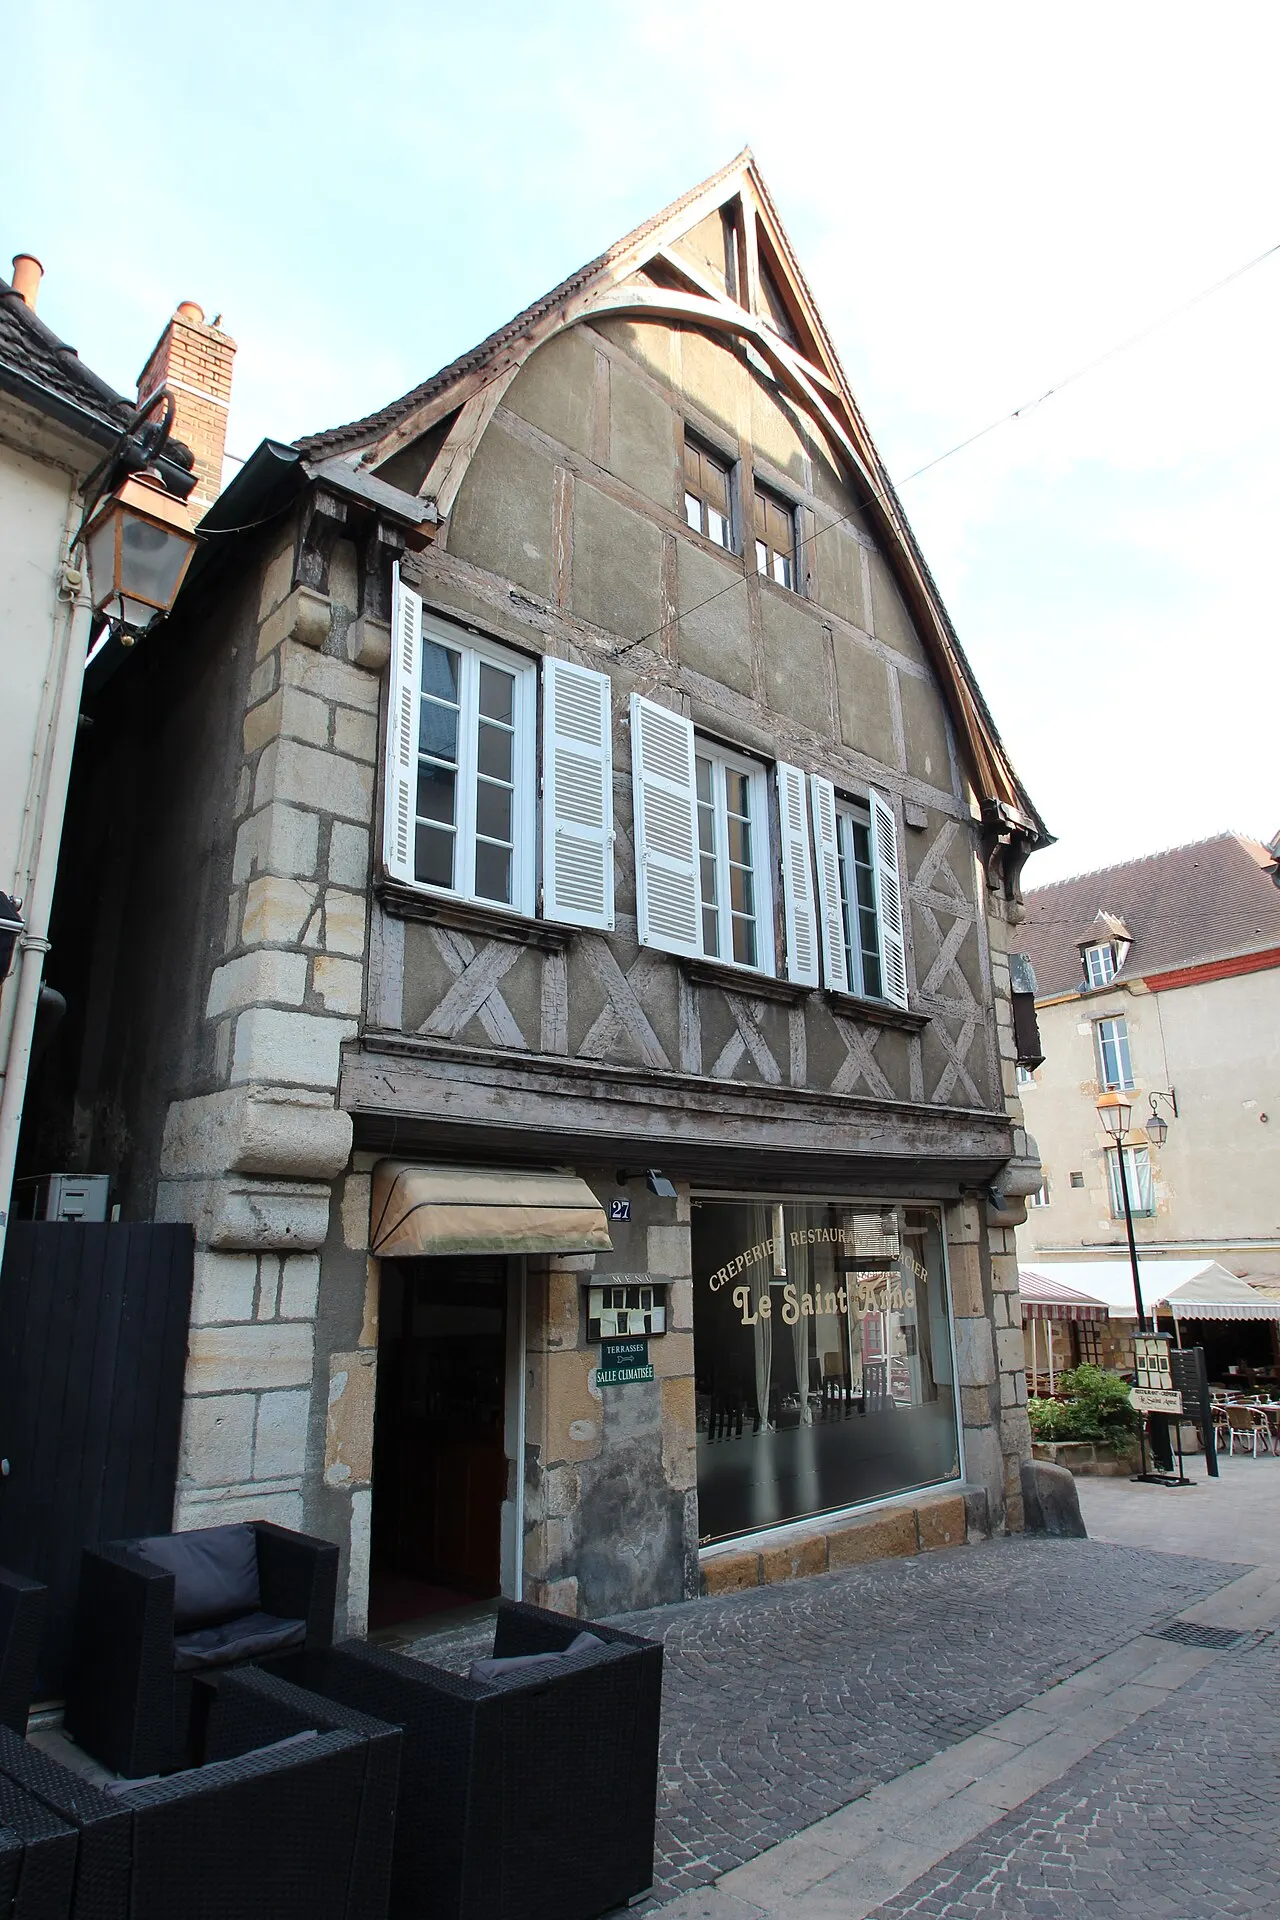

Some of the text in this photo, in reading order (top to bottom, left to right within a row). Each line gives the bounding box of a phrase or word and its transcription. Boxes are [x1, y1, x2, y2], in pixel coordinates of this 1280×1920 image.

[612, 1200, 630, 1219] 27
[709, 1228, 928, 1292] CREPERIE RESTAURA LACIER
[612, 1274, 652, 1284] MENU
[732, 1283, 915, 1326] Le Saint Anne
[607, 1343, 644, 1354] TERRASSES
[597, 1365, 653, 1383] SALLE CLIMATISÉE
